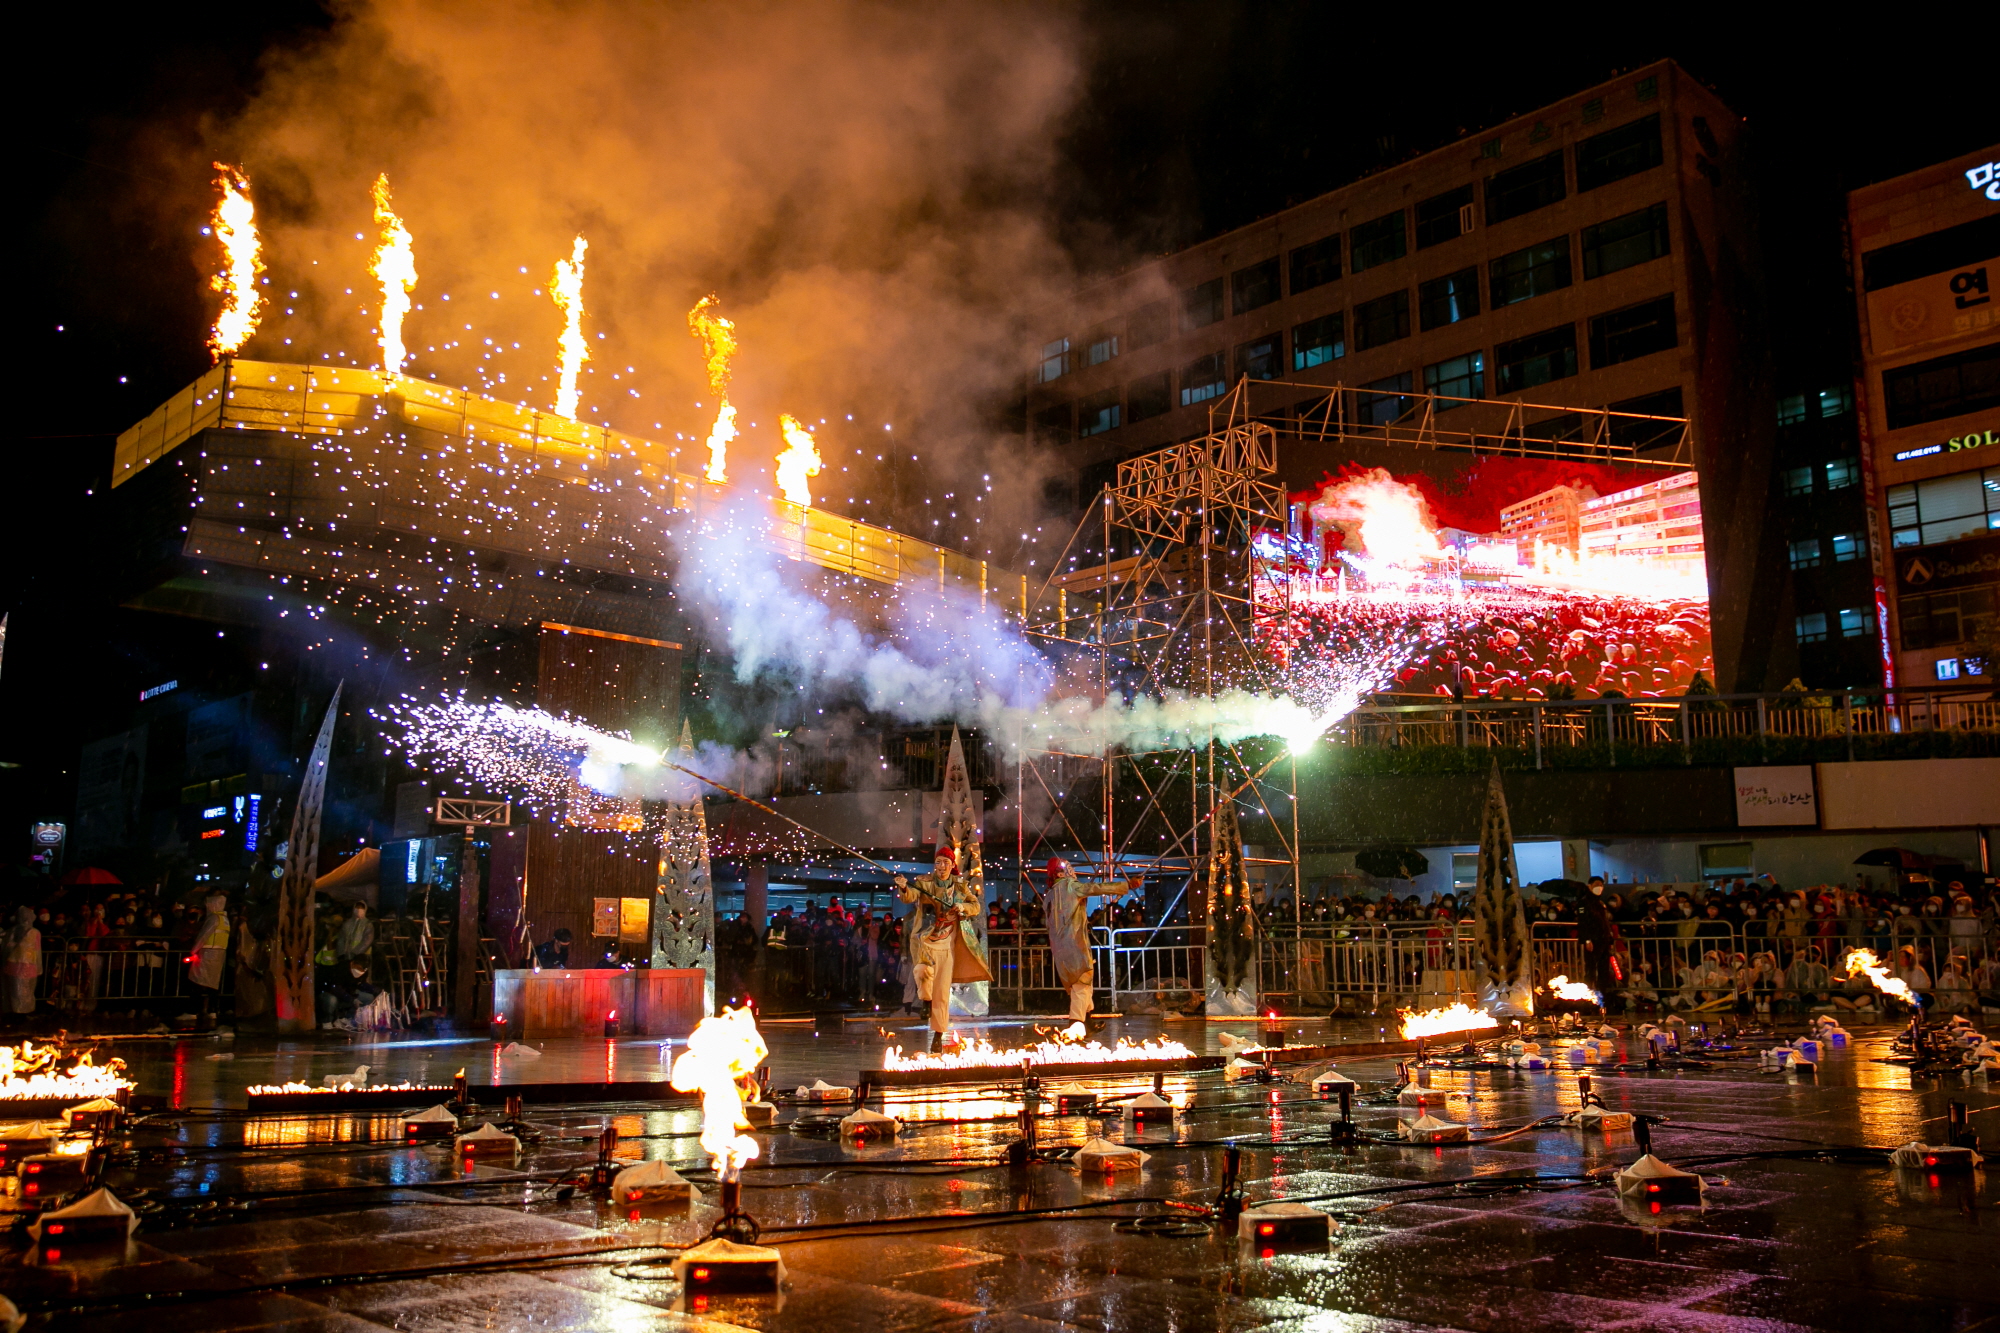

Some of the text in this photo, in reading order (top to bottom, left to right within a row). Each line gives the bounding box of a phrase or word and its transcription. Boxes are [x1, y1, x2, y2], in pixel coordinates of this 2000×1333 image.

[1949, 267, 1991, 310] 연
[1948, 429, 2000, 453] SOL
[144, 679, 178, 700] LOTTE CINEMA
